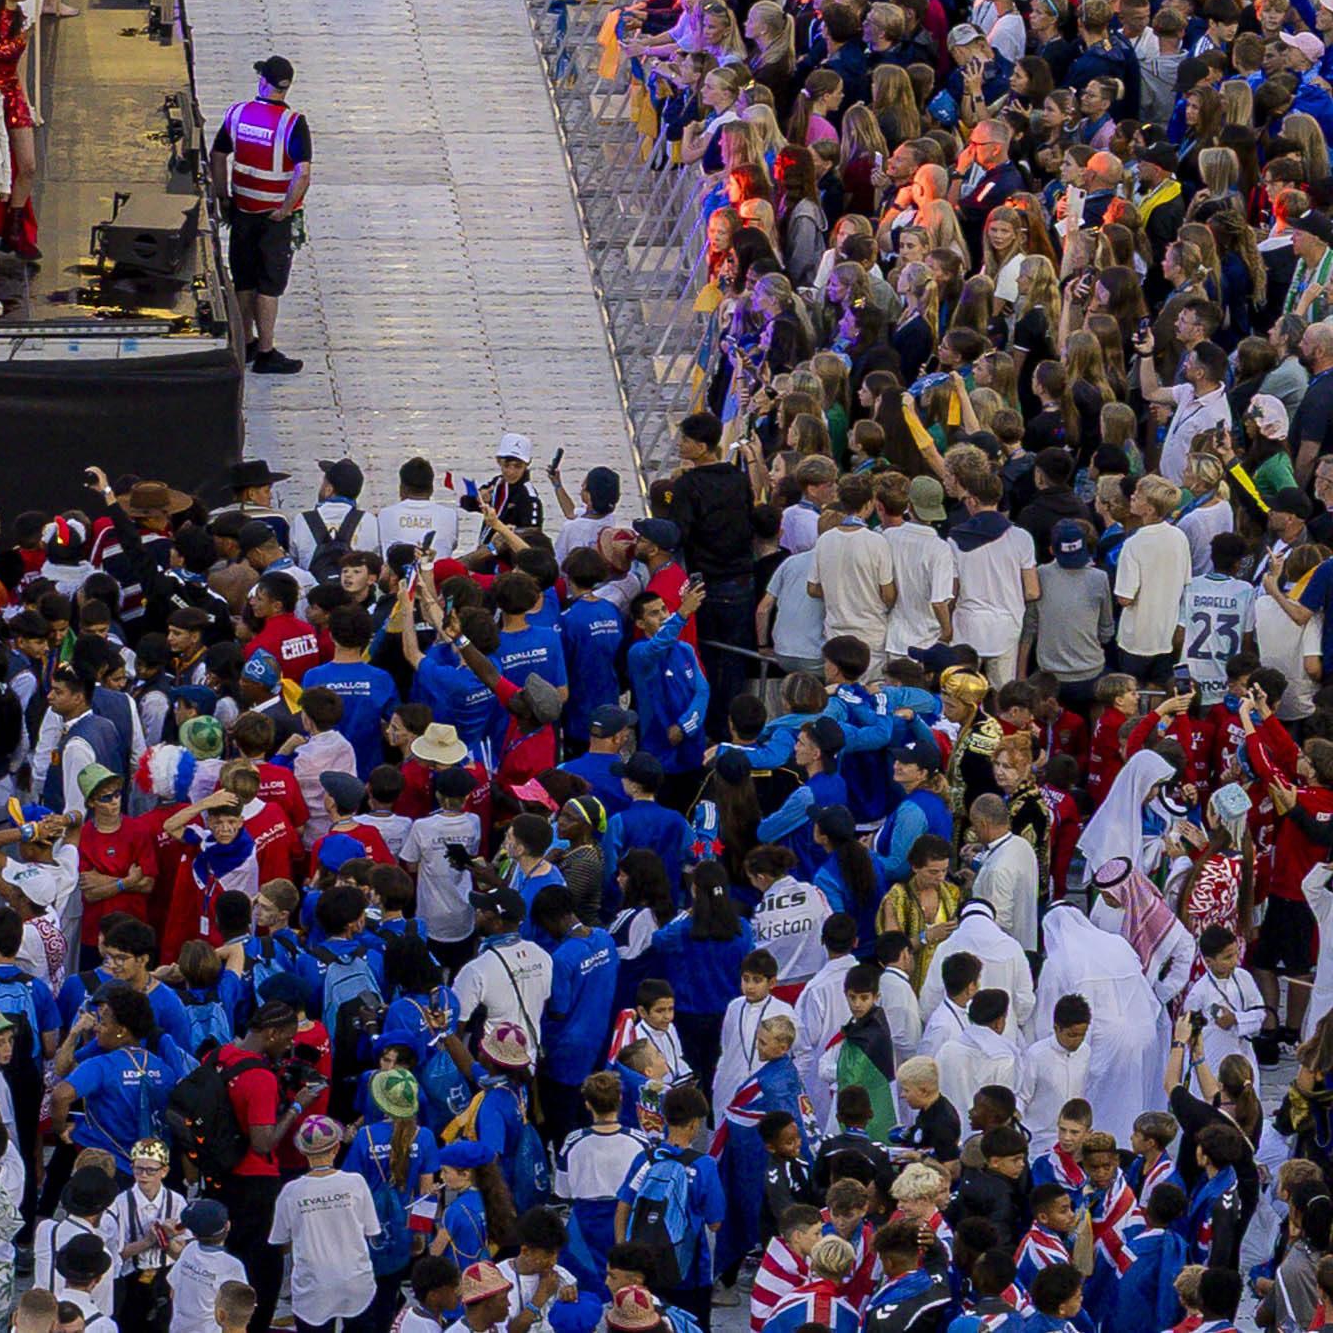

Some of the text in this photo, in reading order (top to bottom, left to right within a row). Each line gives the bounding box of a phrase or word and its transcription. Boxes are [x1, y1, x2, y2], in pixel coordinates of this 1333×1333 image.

[399, 515, 433, 529] COACH
[1194, 596, 1237, 610] BARELLA
[1188, 611, 1240, 660] 23
[281, 639, 318, 660] CHILE
[501, 648, 547, 664] LEVALLOIS
[298, 1191, 351, 1208] LEVALLOIS
